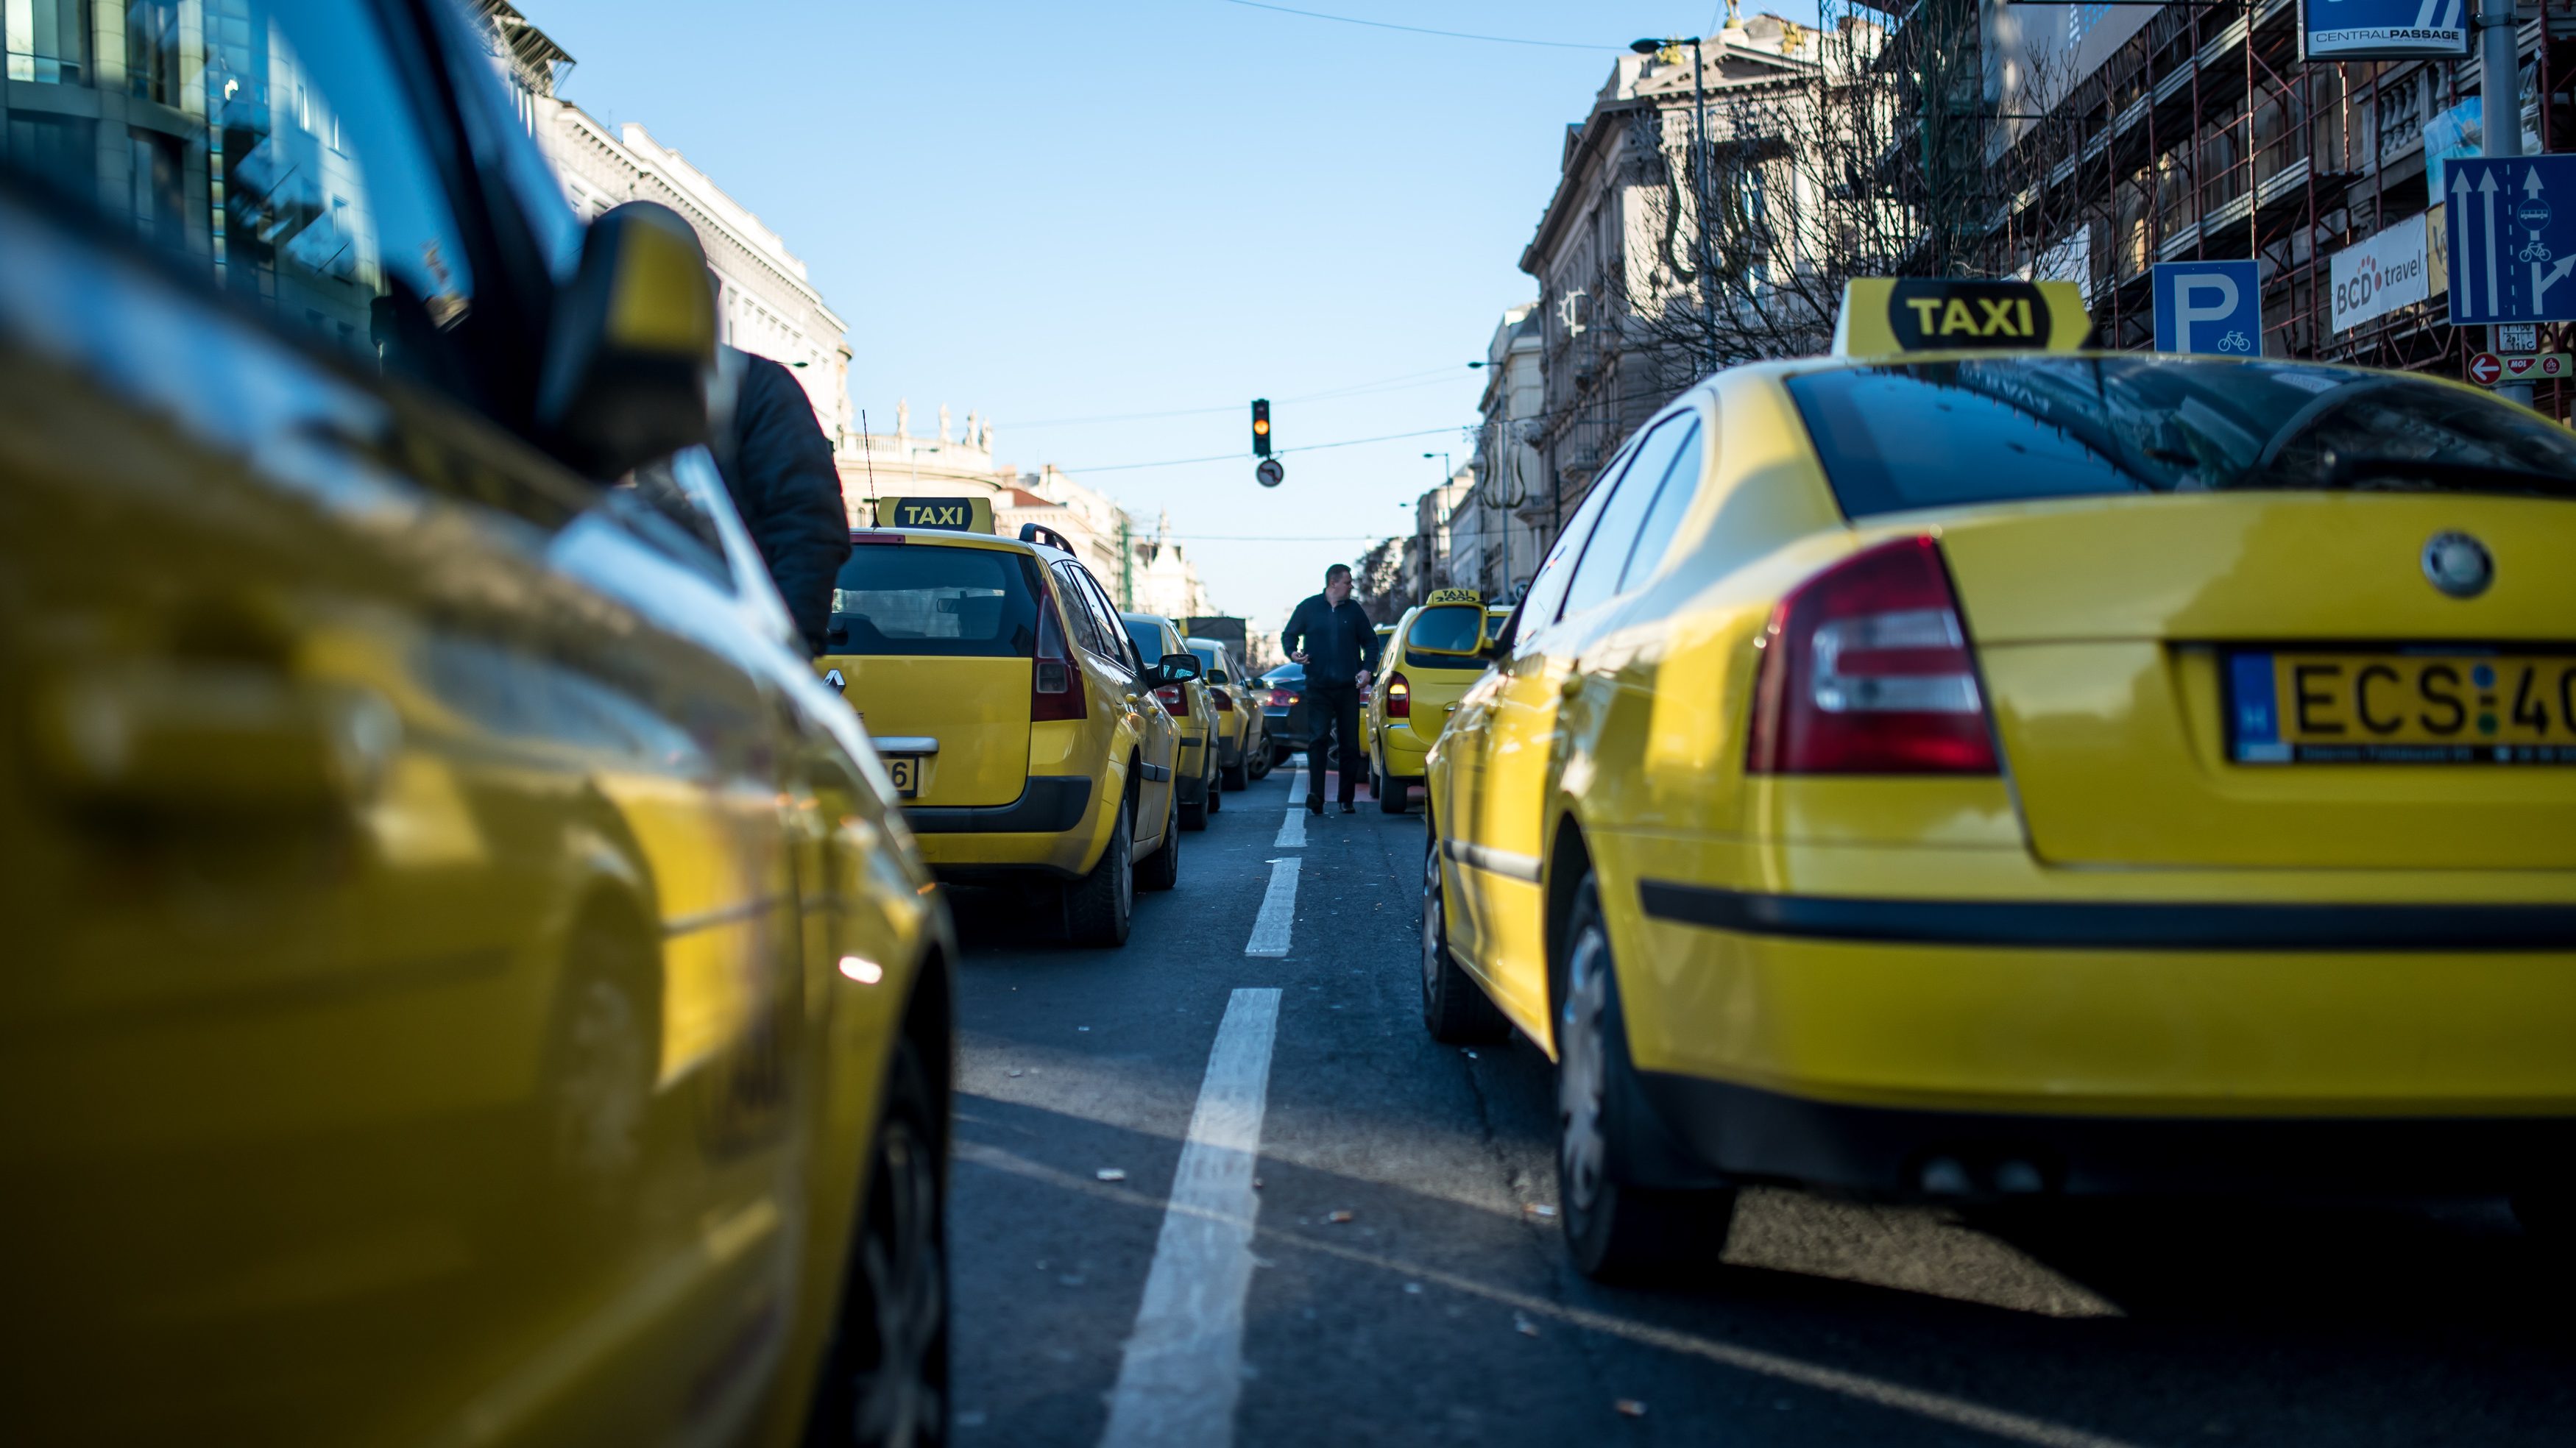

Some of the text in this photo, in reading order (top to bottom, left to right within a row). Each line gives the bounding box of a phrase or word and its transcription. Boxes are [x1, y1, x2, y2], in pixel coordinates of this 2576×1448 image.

[2337, 273, 2372, 316] BCD
[2385, 249, 2421, 287] travel
[1906, 297, 2035, 336] TAXI
[2174, 273, 2239, 354] P
[904, 506, 963, 525] TAXI
